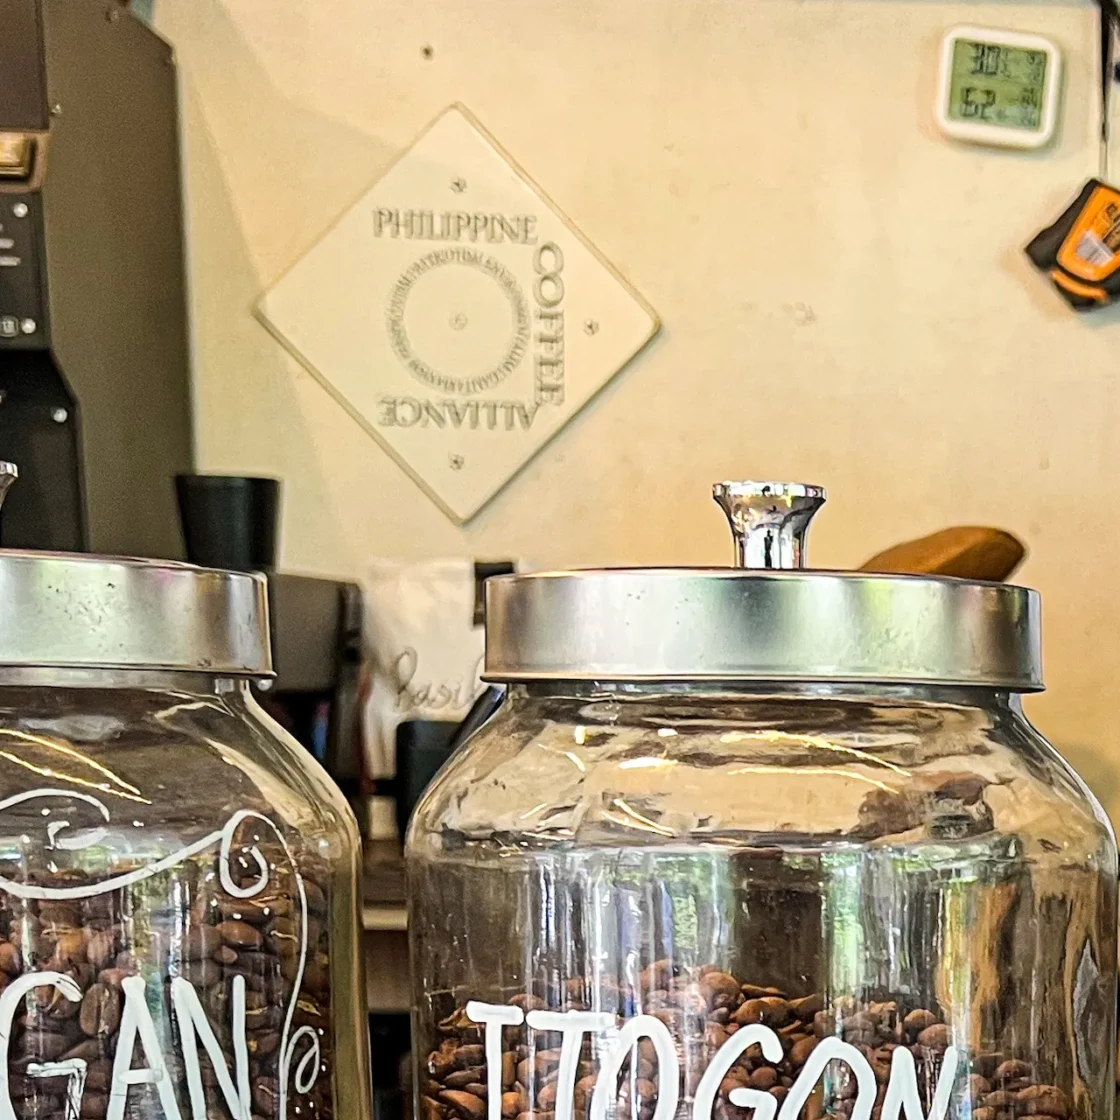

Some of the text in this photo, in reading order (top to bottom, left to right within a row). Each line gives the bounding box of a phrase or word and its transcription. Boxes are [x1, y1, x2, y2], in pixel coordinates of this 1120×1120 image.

[373, 206, 539, 243] PHILIPPINE
[532, 241, 566, 406] COFFEE
[377, 396, 543, 432] ALLIANCE
